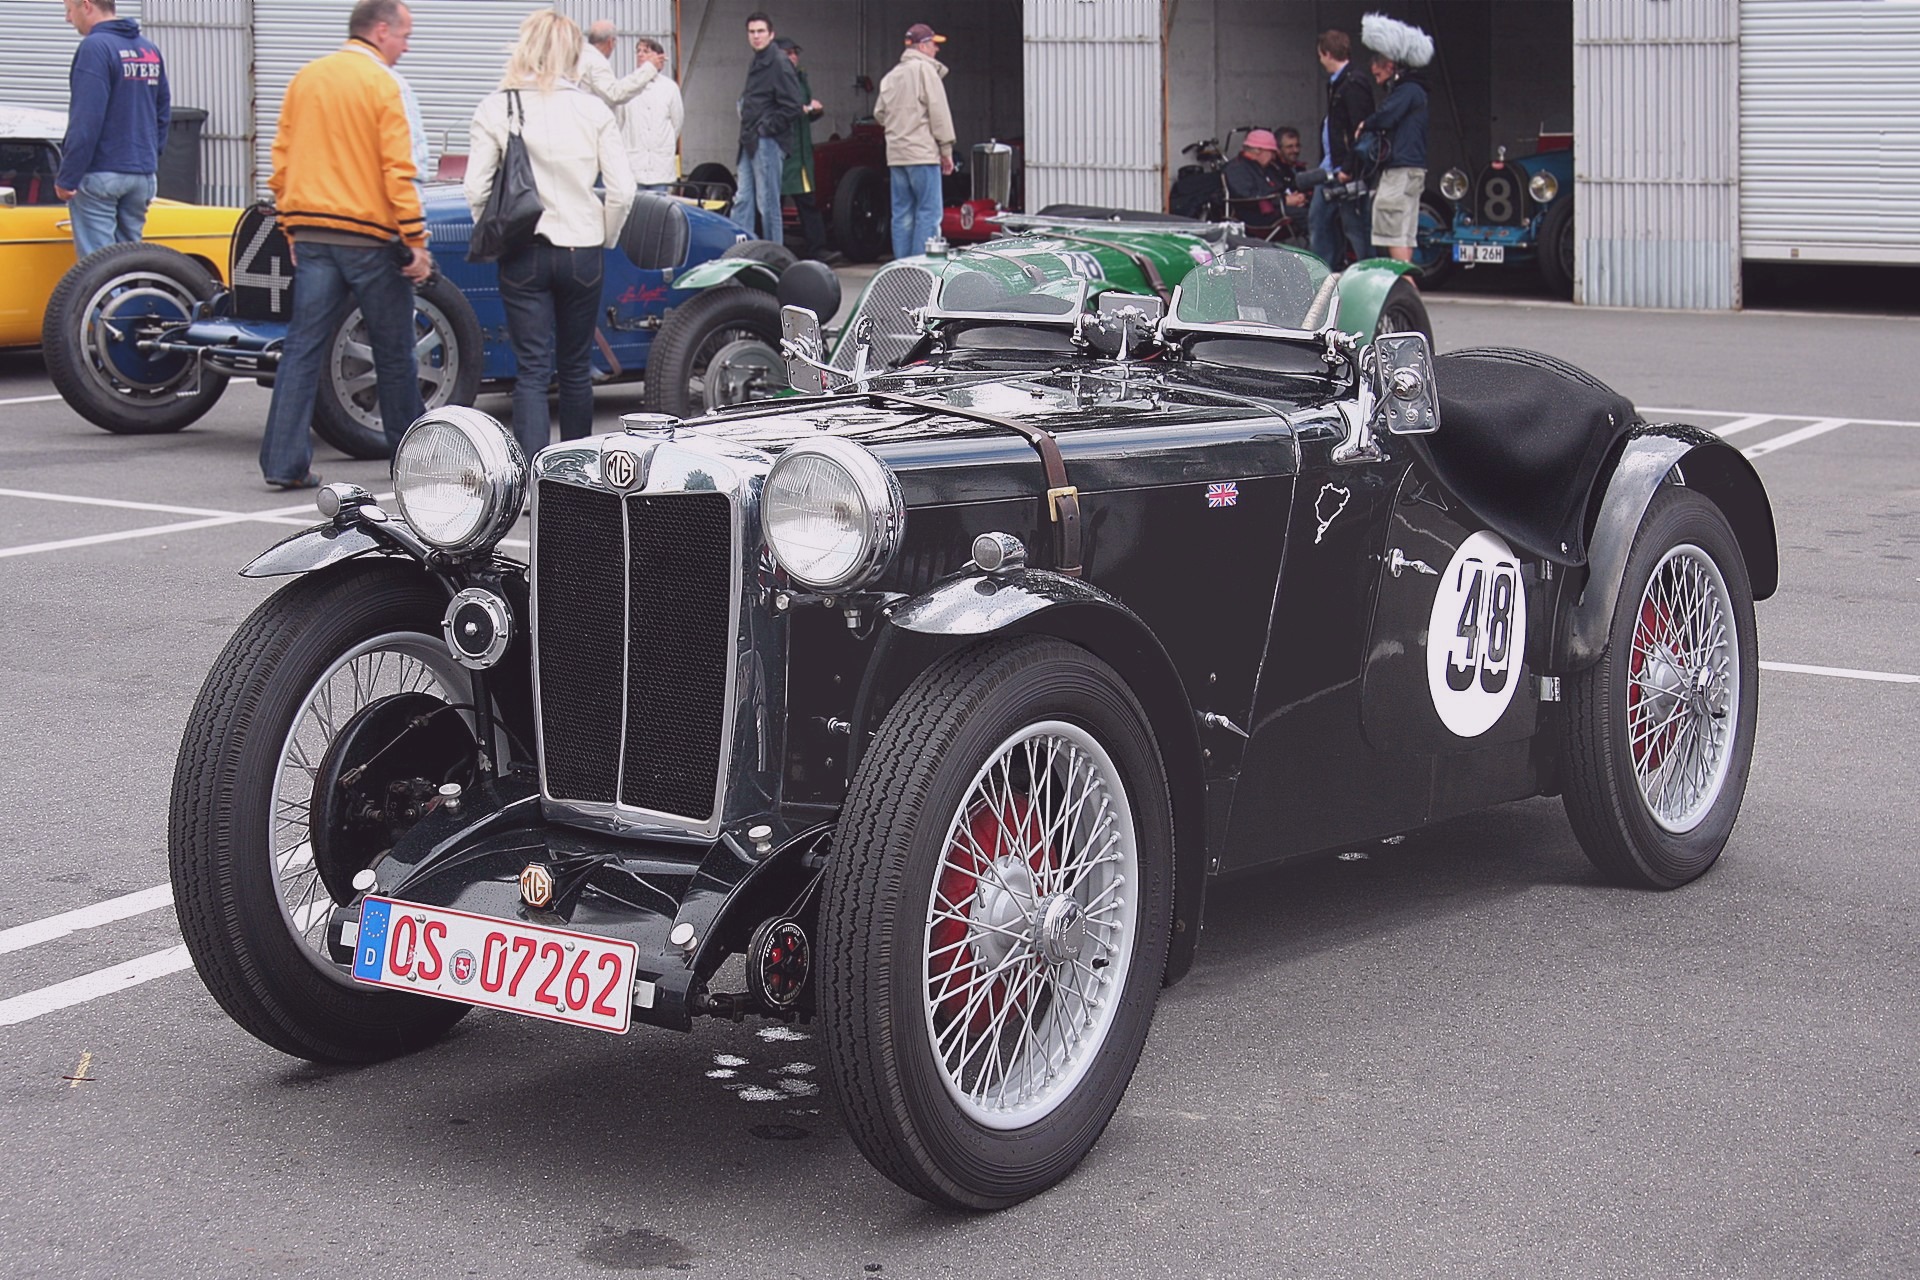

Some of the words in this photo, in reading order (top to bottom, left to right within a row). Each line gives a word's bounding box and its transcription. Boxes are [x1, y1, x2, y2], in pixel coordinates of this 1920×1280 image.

[1484, 177, 1513, 222] 8
[234, 215, 293, 313] 4
[607, 454, 631, 484] MG
[1455, 567, 1513, 666] 48
[522, 871, 546, 902] MG
[364, 948, 376, 966] D
[389, 915, 447, 981] OS
[480, 931, 622, 1017] 07262
